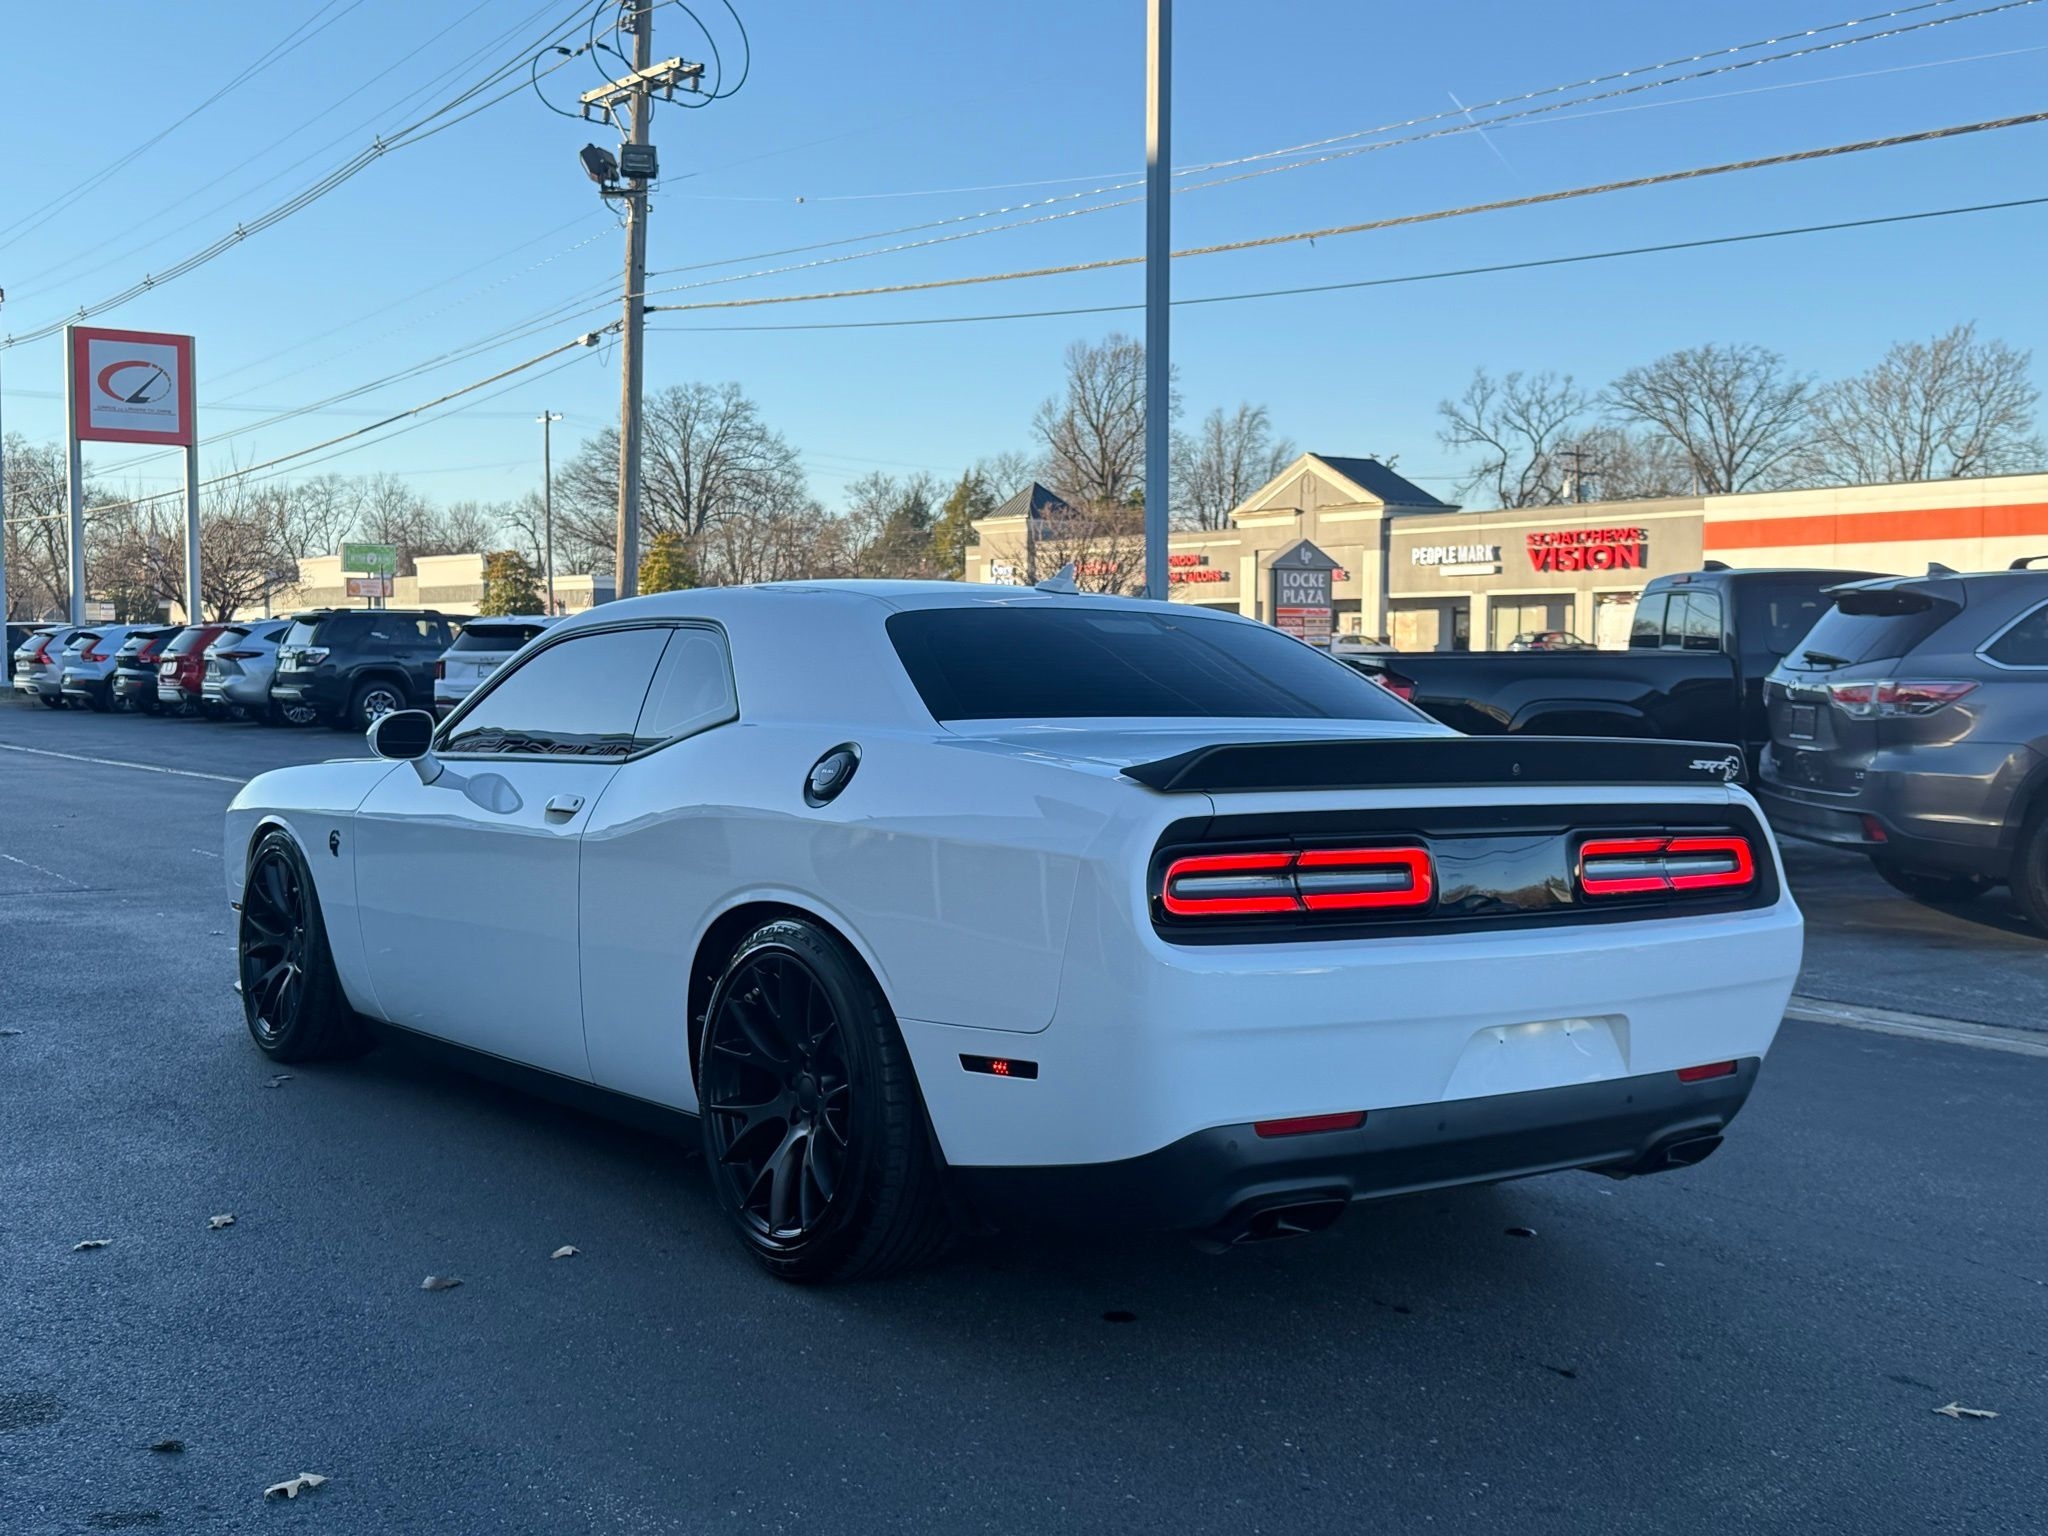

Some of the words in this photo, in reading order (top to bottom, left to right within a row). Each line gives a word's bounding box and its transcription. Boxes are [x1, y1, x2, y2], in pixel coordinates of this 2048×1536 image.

[1411, 546, 1457, 566] PEOPLE
[1458, 544, 1494, 563] MARK
[1527, 543, 1641, 573] VISION
[1282, 572, 1326, 588] LOCKE
[1282, 589, 1325, 605] PLAZA
